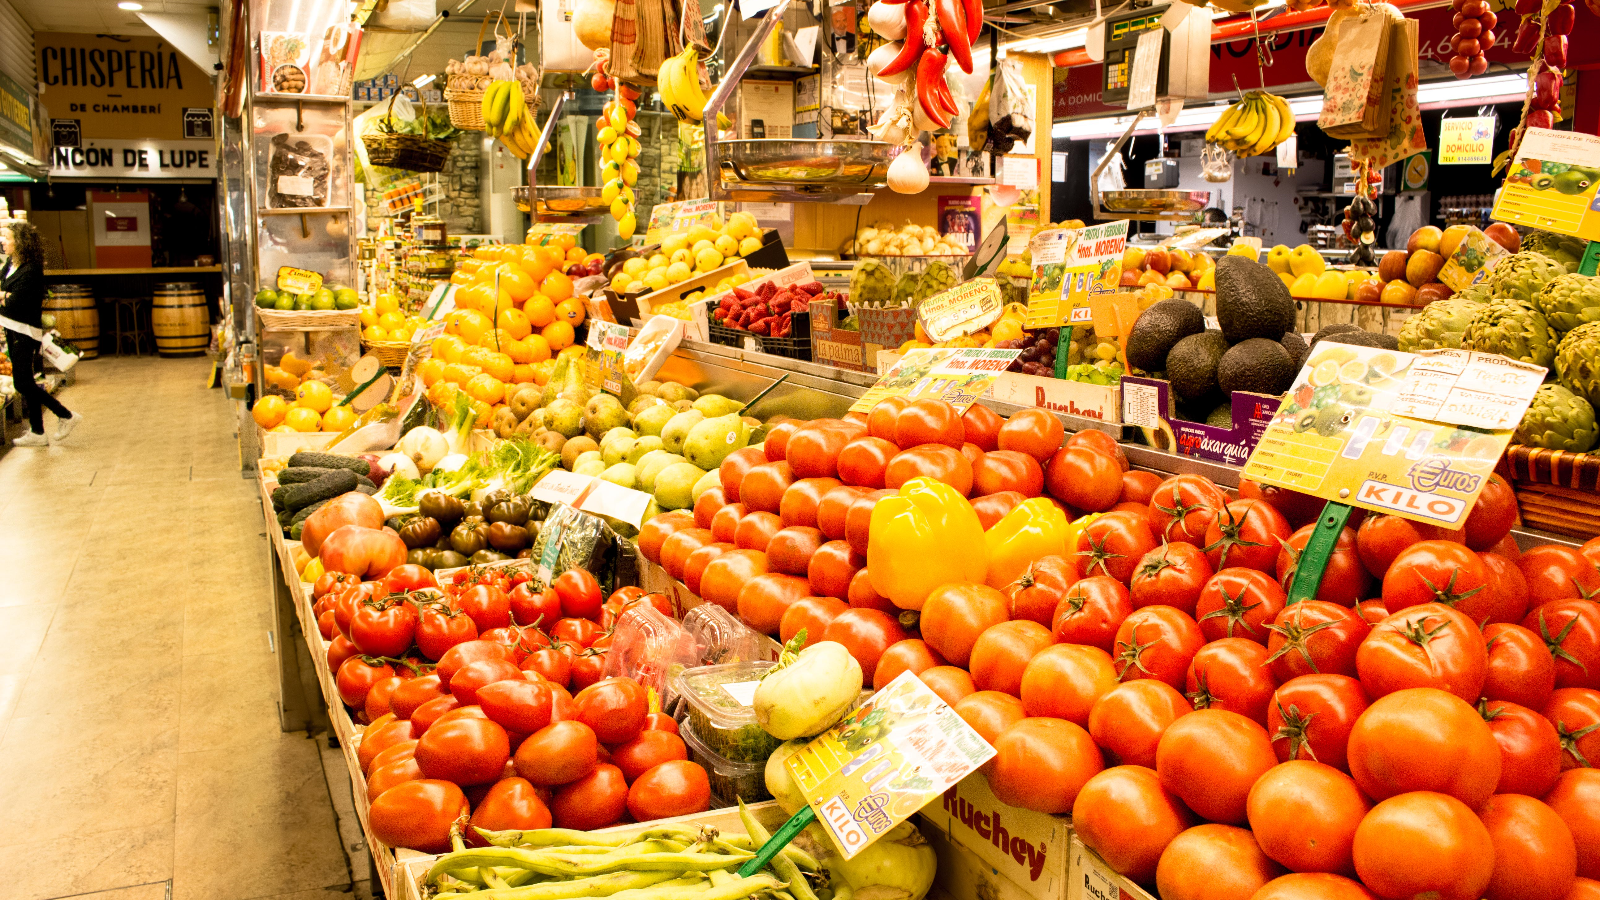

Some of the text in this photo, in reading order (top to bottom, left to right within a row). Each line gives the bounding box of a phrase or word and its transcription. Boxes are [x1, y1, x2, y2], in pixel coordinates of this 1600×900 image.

[41, 43, 183, 90] CHISPERÍA
[70, 103, 161, 114] DE CHAMBERÍ
[1445, 121, 1473, 131] SERVICIO
[1457, 132, 1463, 142] A
[1445, 143, 1485, 153] DOMICILIO
[123, 149, 149, 168] DE
[159, 150, 209, 168] LUPE
[694, 203, 717, 212] MORENO
[1083, 227, 1101, 241] FRUTAS
[1103, 222, 1128, 238] VERDURAS
[1077, 243, 1093, 259] Hnos.
[1093, 237, 1125, 257] MORENO
[922, 295, 946, 308] FRUTAS
[950, 280, 984, 298] VERDURAS
[924, 284, 989, 316] Hnos. MORENO
[1073, 310, 1092, 320] KI
[828, 342, 861, 364] palma
[961, 348, 982, 357] FRUTAS
[987, 349, 1019, 359] VERDURAS
[945, 359, 1011, 372] Hnos. MORENO
[604, 380, 620, 392] KILO
[1367, 471, 1388, 482] P.V.P.
[1363, 485, 1456, 516] KILO
[825, 801, 861, 846] KILO
